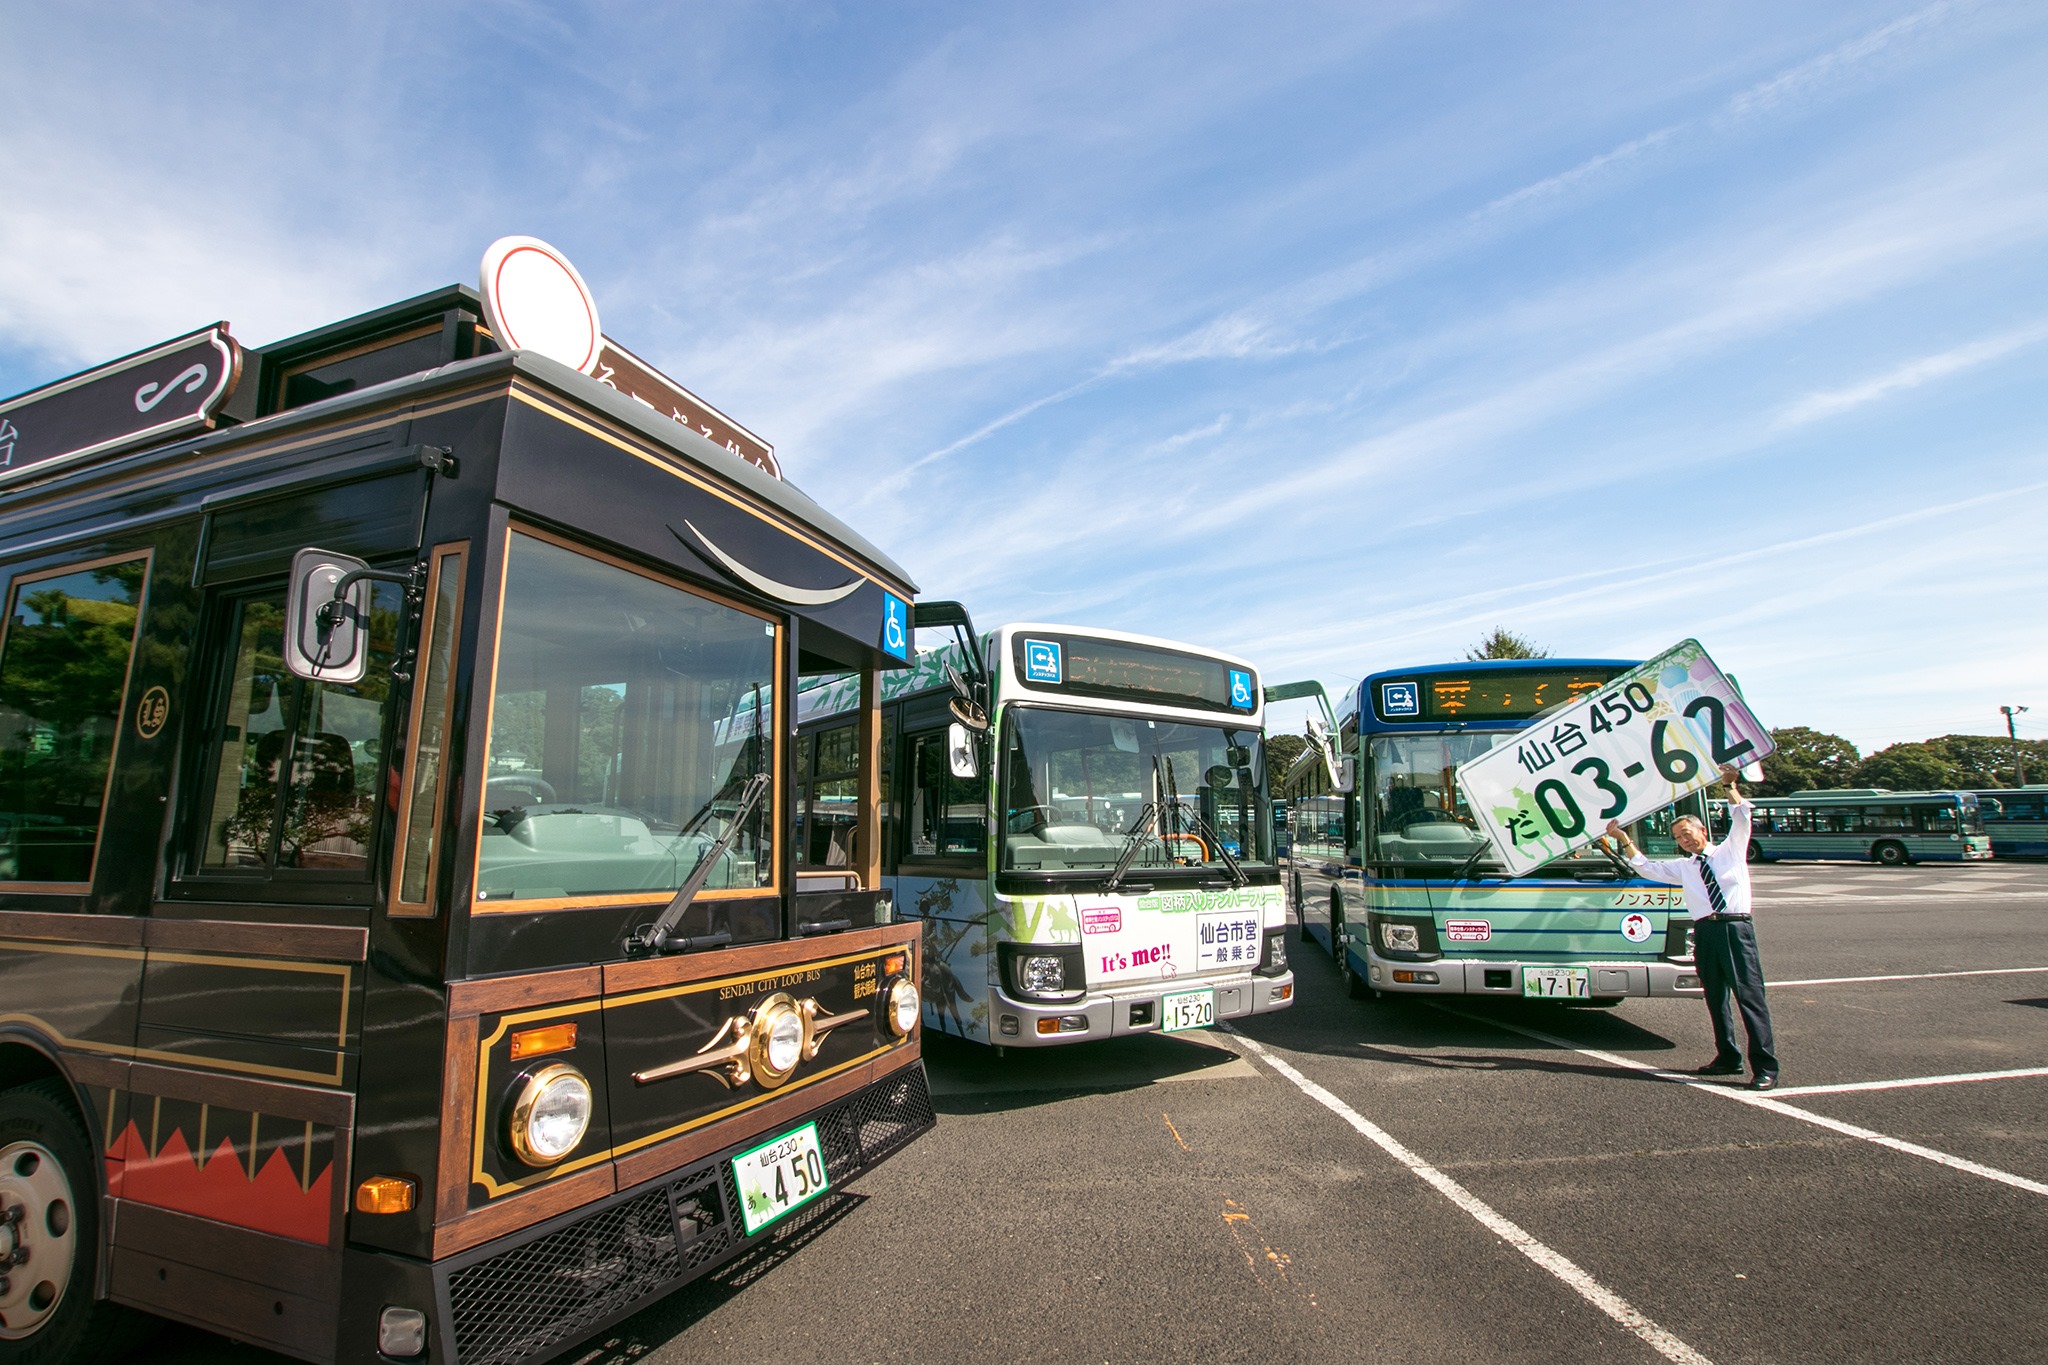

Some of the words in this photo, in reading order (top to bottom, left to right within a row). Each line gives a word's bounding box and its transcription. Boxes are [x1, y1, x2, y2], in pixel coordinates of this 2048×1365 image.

[1534, 695, 1754, 839] 03-62
[1161, 888, 1283, 912] 図柄入りナンバープレート
[1615, 894, 1682, 906] ノンステッ
[1200, 919, 1257, 945] 仙台市営
[1101, 952, 1127, 973] It's
[1131, 943, 1171, 967] me!!
[1201, 944, 1256, 963] 一般乗合
[719, 983, 755, 1000] SENDAI
[757, 978, 779, 992] CITY
[781, 973, 804, 987] LOOP
[806, 969, 821, 982] BUS
[1537, 977, 1587, 996] 17-17
[1175, 1002, 1212, 1028] 15-20
